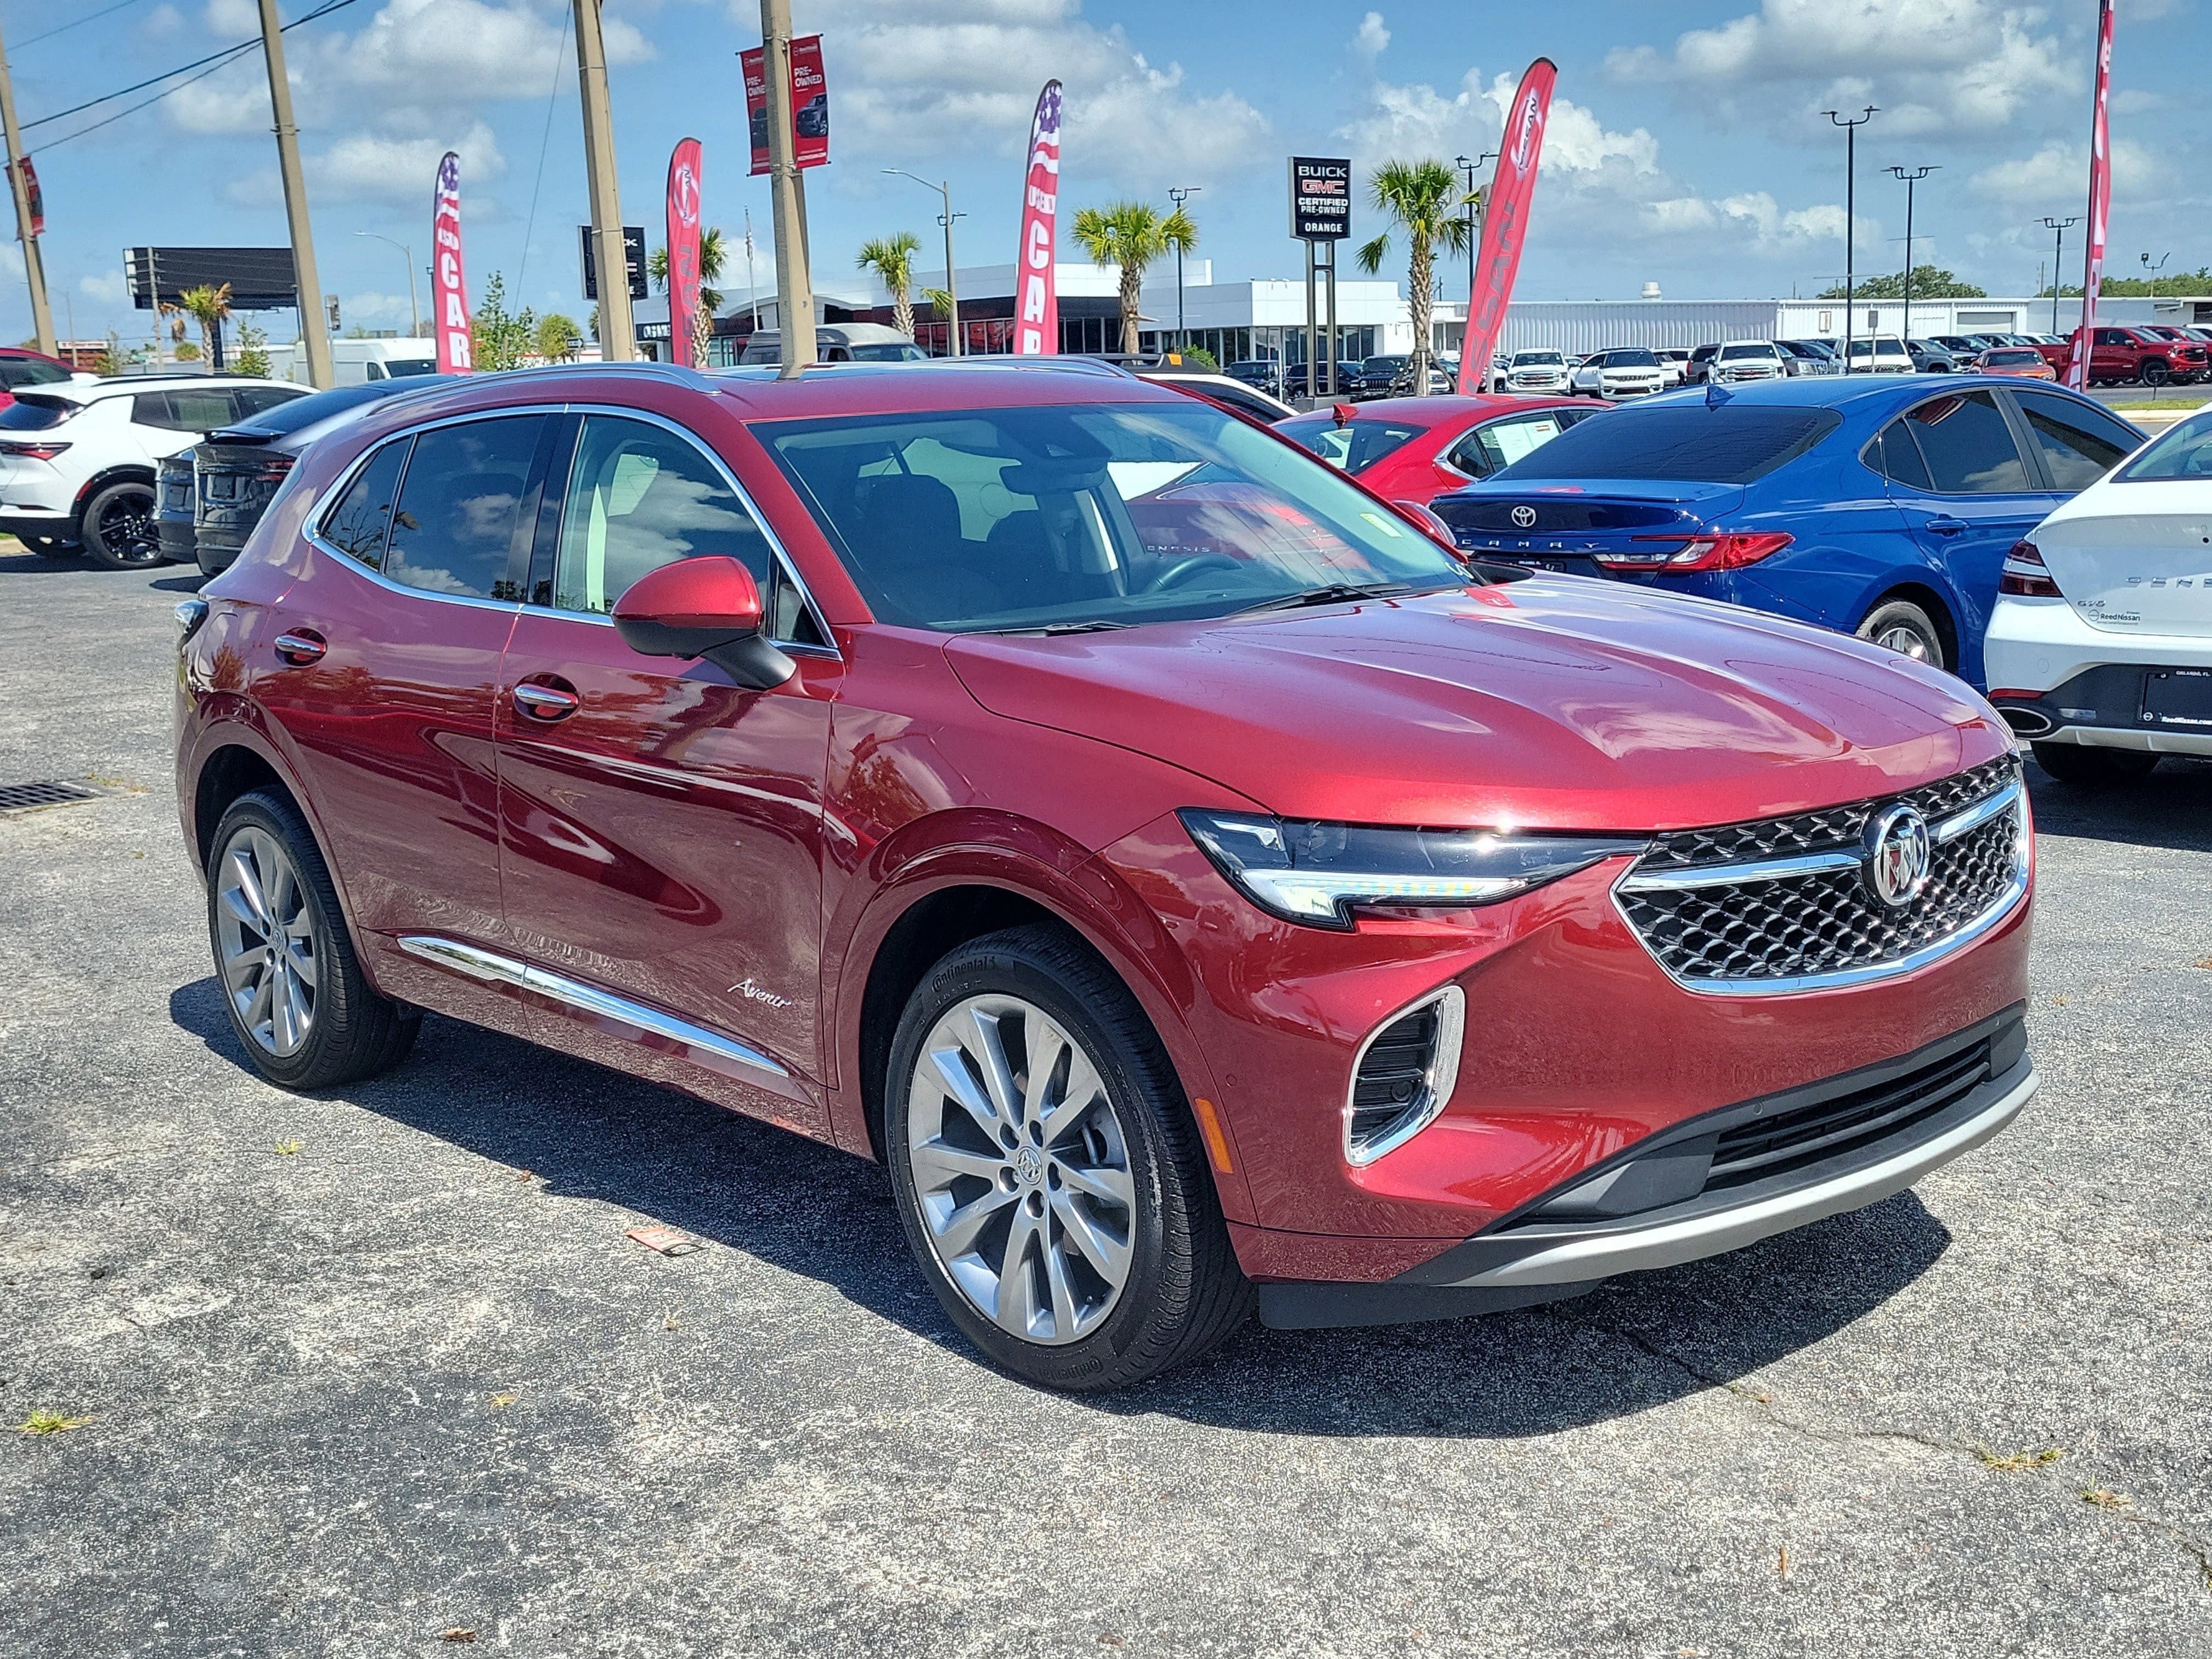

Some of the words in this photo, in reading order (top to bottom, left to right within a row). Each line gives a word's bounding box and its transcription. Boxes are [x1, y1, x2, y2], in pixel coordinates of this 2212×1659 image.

[793, 66, 812, 77] PRE-
[795, 74, 823, 87] OWNED
[748, 84, 766, 97] OWNE
[1298, 166, 1347, 178] BUICK
[1302, 179, 1345, 194] GMC
[1298, 198, 1348, 206] CERTIFIED
[1301, 206, 1346, 214] PRE-OWNED
[1305, 222, 1343, 233] ORANGE
[1465, 198, 1515, 394] ISSAN
[441, 252, 471, 369] CAR
[1461, 539, 1600, 549] CAMRY
[727, 978, 793, 1008] Avenir
